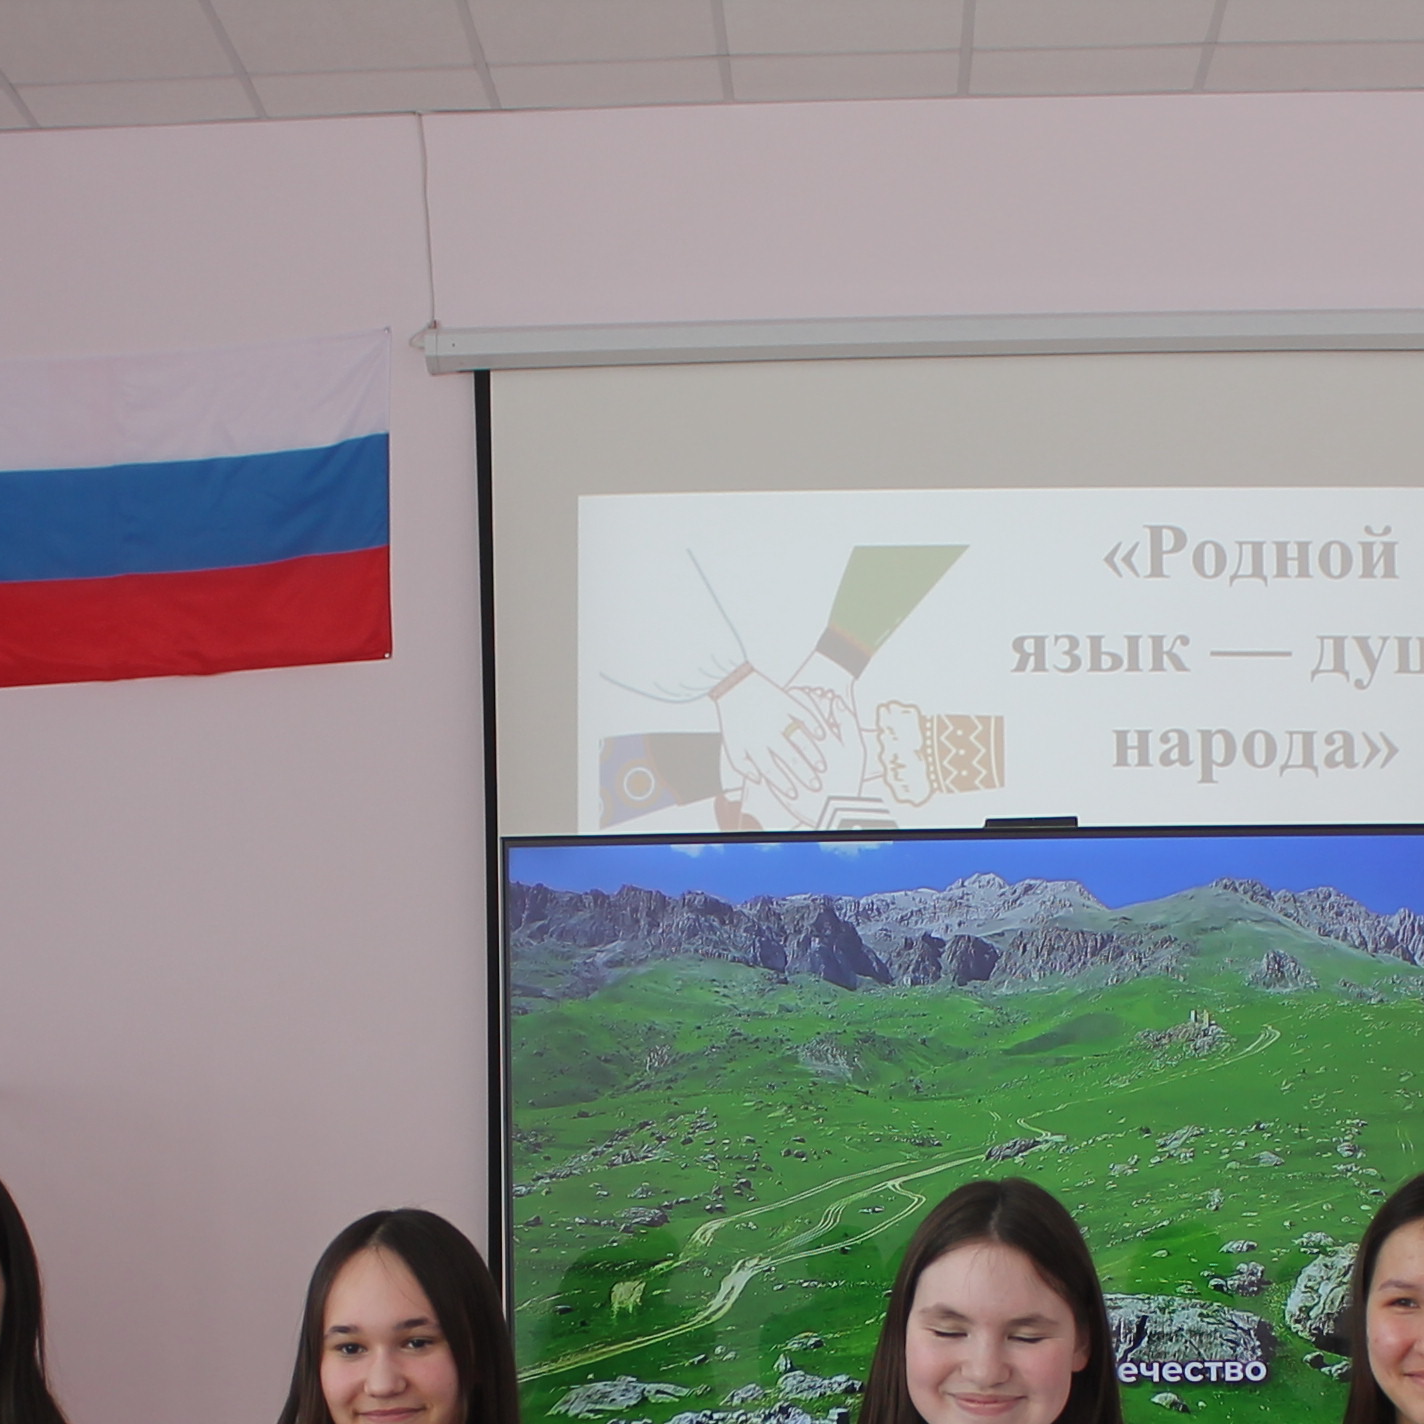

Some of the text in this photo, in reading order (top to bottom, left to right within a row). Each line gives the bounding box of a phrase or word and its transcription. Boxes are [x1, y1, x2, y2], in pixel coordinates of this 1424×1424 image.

[1102, 524, 1400, 587] «Родной
[1010, 633, 1191, 676] язык
[1111, 726, 1401, 785] народа»
[1118, 1361, 1268, 1383] ечество
